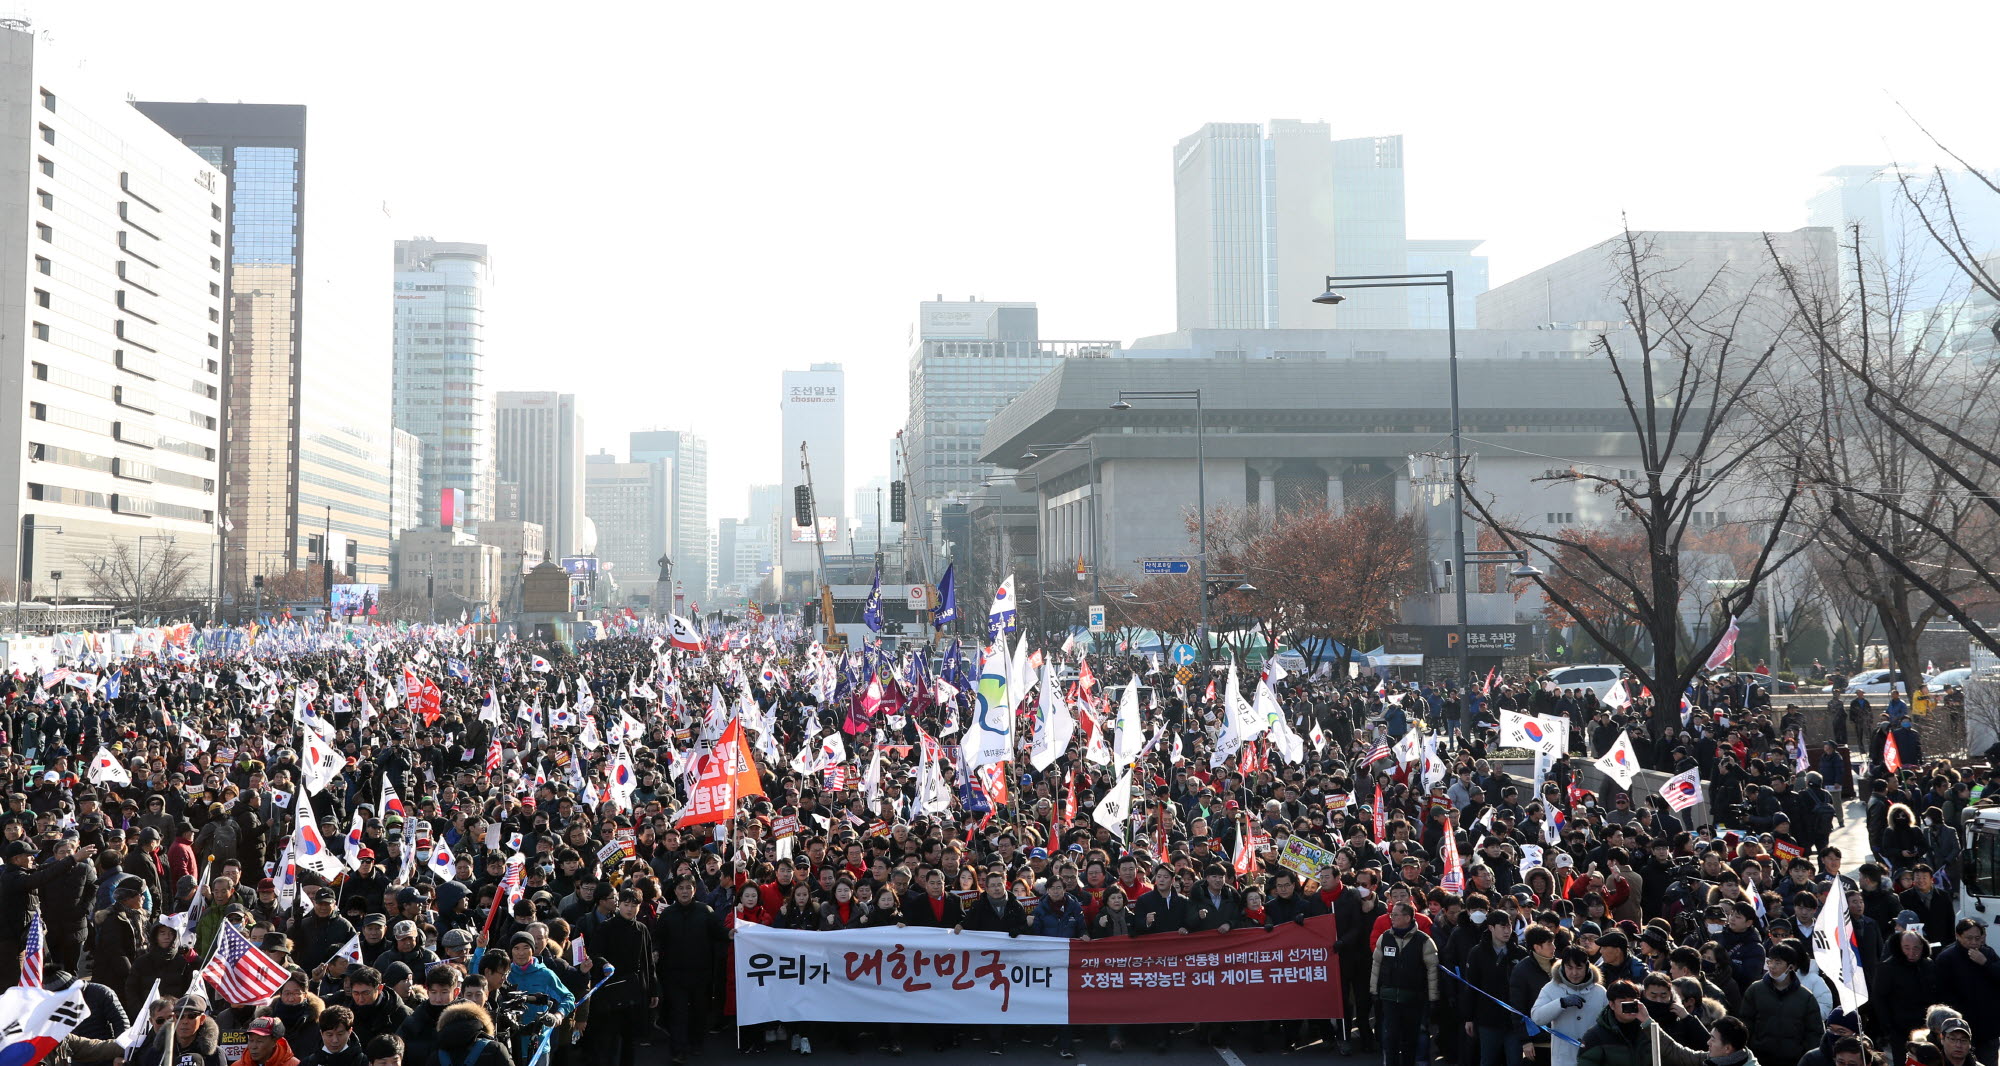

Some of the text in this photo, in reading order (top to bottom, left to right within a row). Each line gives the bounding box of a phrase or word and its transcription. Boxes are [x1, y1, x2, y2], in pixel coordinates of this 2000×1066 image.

[790, 386, 837, 396] 조선일보
[791, 395, 835, 403] chosun.com
[1447, 632, 1460, 648] P
[1490, 631, 1516, 644] 주차장
[1081, 958, 1100, 968] 2대
[1224, 950, 1283, 964] 비례대표제
[1288, 947, 1328, 962] 선거법)
[747, 953, 830, 986] 우리가
[1081, 966, 1327, 988] 文정권 국정농단 3대 게이트 규탄대회
